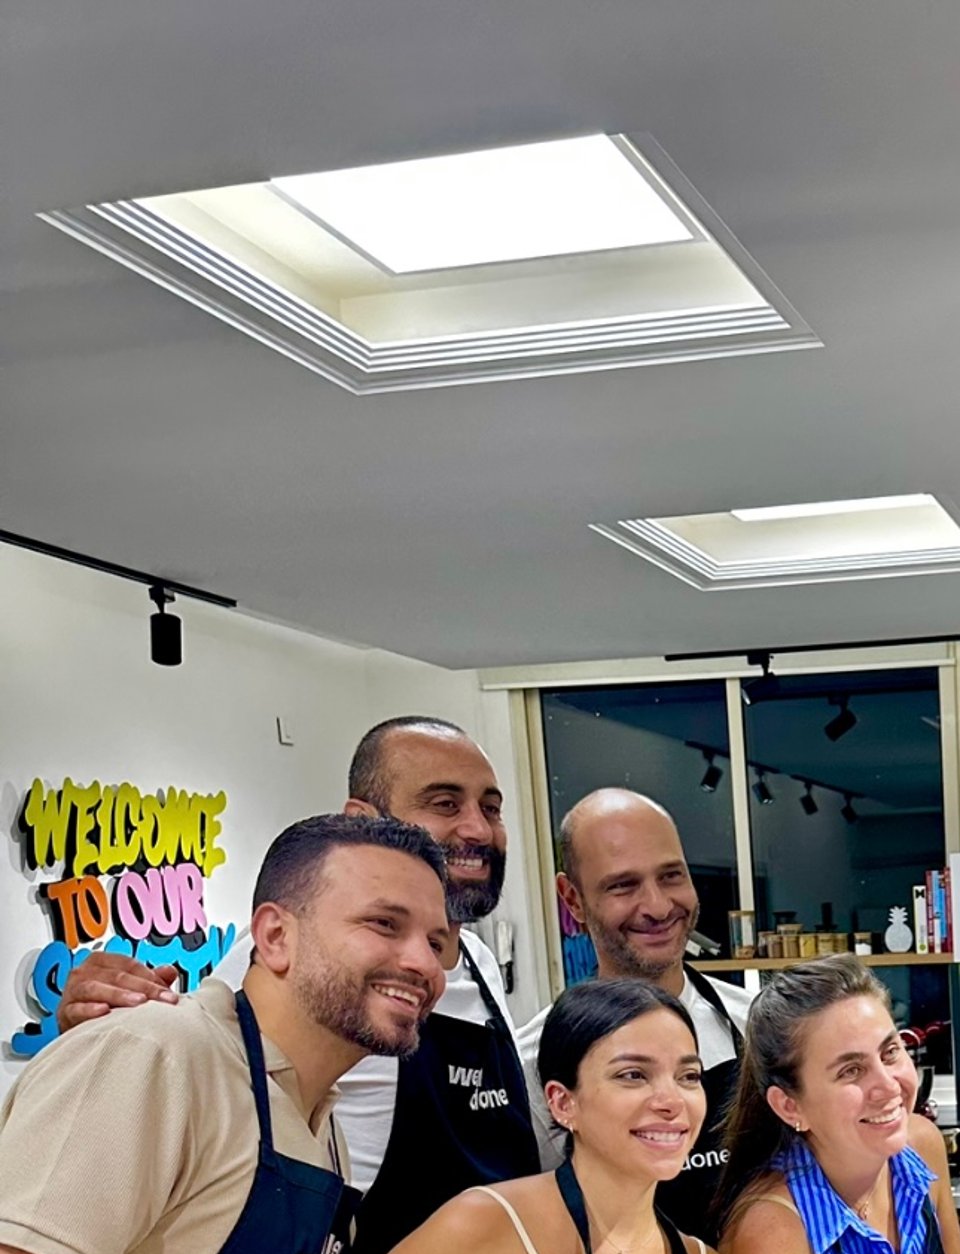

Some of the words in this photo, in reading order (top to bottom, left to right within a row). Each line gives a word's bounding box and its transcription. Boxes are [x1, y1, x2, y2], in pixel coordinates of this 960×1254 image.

[25, 776, 228, 878] WELCOME
[47, 875, 108, 949] TO
[117, 863, 208, 940] OUR
[448, 1064, 483, 1087] wel
[469, 1087, 509, 1111] done
